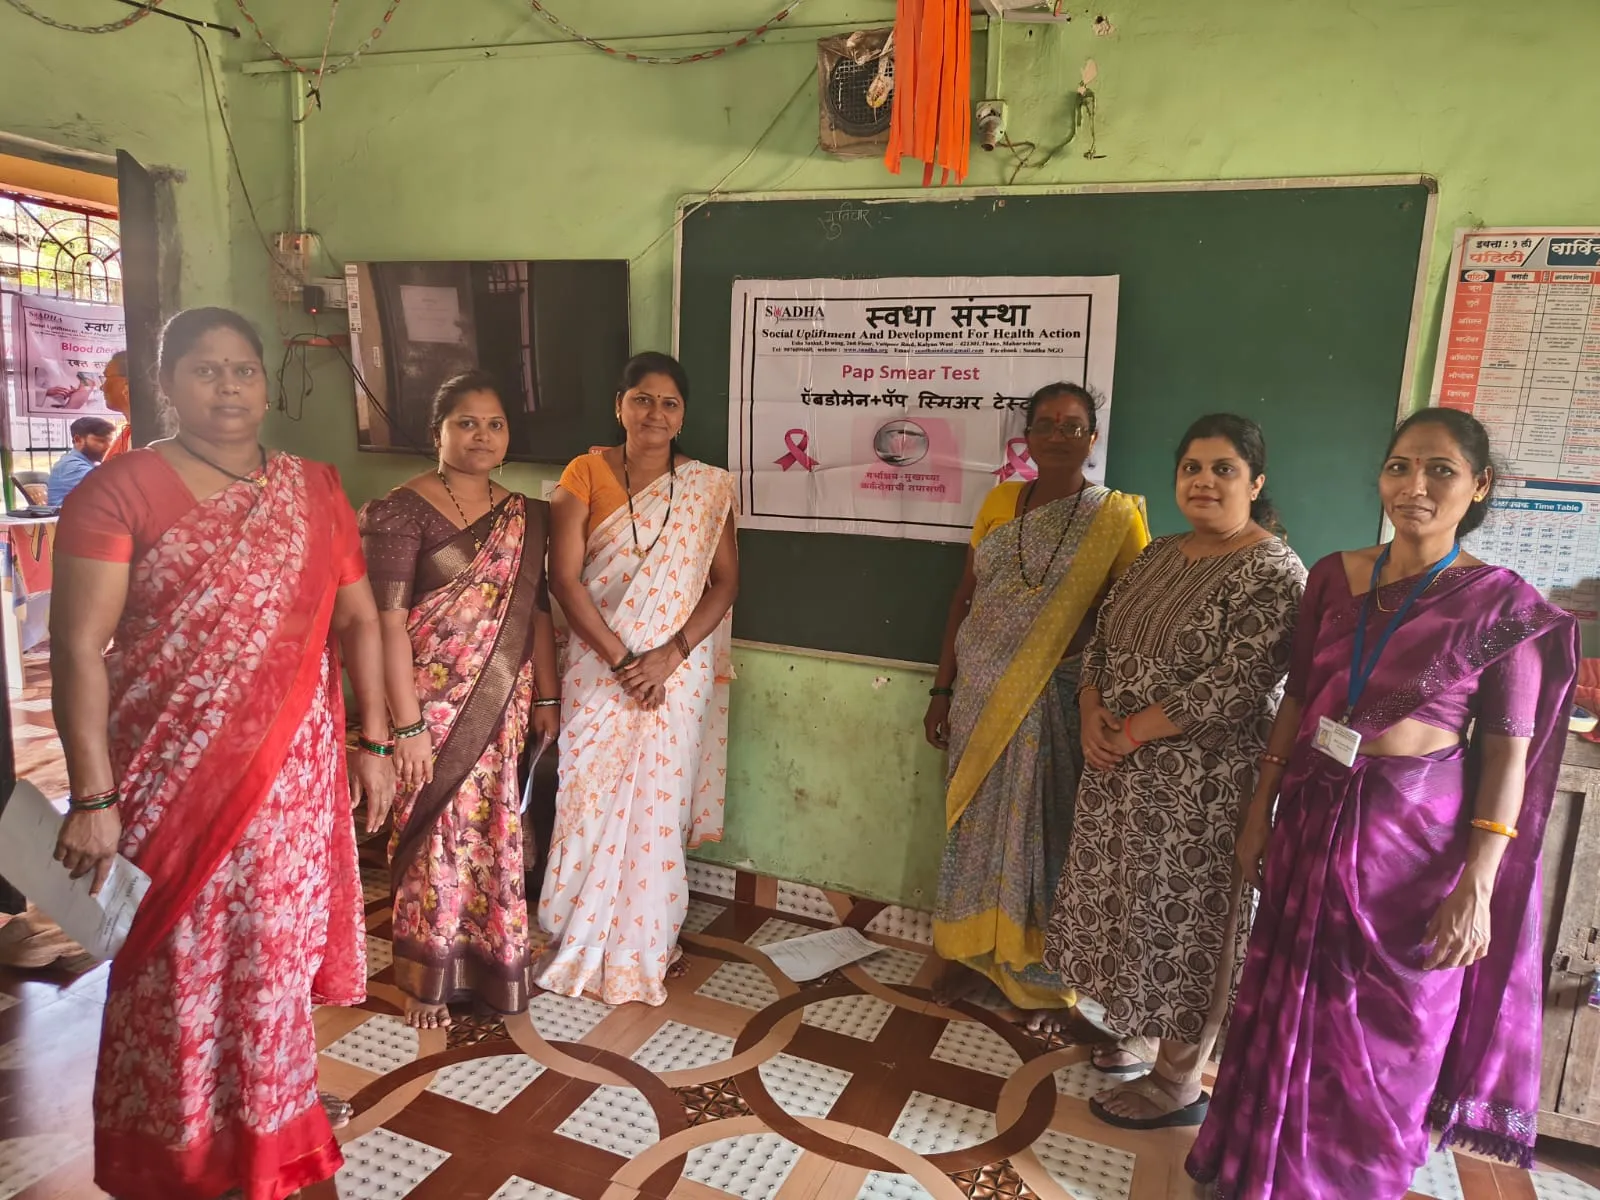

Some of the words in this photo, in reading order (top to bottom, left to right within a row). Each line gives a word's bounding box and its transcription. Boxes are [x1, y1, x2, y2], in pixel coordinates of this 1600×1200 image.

[1469, 250, 1525, 264] पहिली
[866, 305, 936, 329] स्वधा
[951, 297, 1031, 328] संस्था
[84, 321, 114, 333] स्वधा
[762, 329, 793, 339] Social
[796, 329, 856, 341] Upliftment
[860, 330, 884, 340] And
[888, 329, 963, 341] Development
[967, 329, 989, 339] For
[993, 328, 1034, 339] Health
[1039, 328, 1081, 339] Action
[61, 342, 93, 353] Blood
[842, 365, 875, 381] Pap
[879, 365, 935, 380] Smear
[941, 366, 980, 381] Test
[918, 390, 984, 410] स्मिअर
[1534, 502, 1554, 510] Time
[1557, 504, 1579, 512] Table
